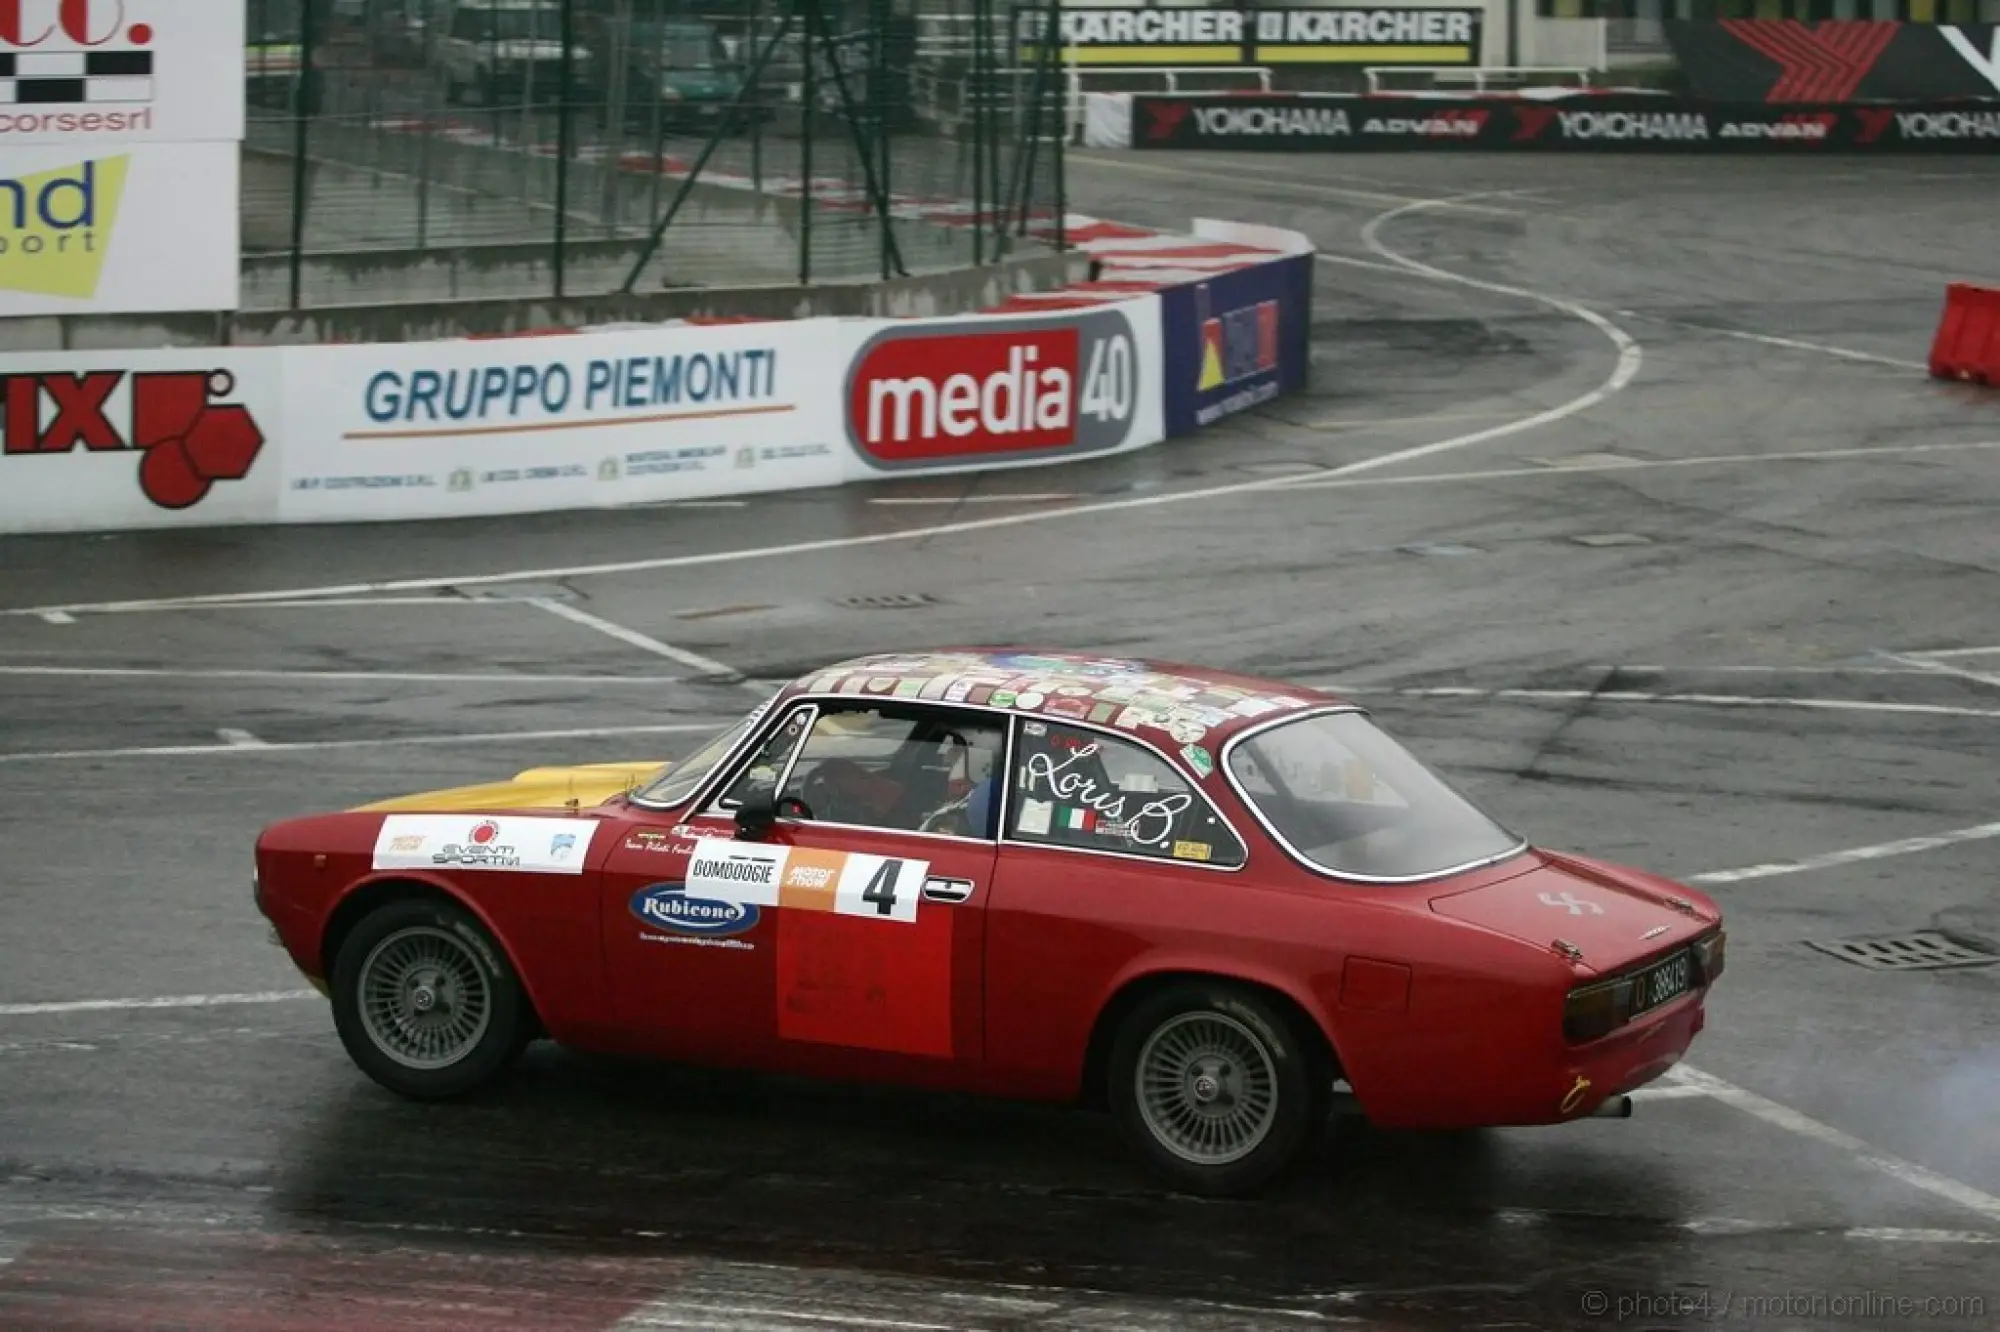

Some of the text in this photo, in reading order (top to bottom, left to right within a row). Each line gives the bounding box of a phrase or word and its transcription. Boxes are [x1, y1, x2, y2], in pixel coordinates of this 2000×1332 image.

[1193, 107, 1479, 135] YOKOHAMA ADVAN
[1557, 110, 1827, 139] YOKOHAMA ADVAN
[365, 348, 777, 422] GRUPPO PIEMONTI
[868, 345, 1071, 443] media
[1081, 334, 1132, 422] 40
[1028, 743, 1127, 818] Loris
[432, 853, 521, 866] SPORTIVI
[443, 843, 515, 855] EVENTI
[862, 858, 904, 916] 4
[642, 897, 739, 921] Rubicone
